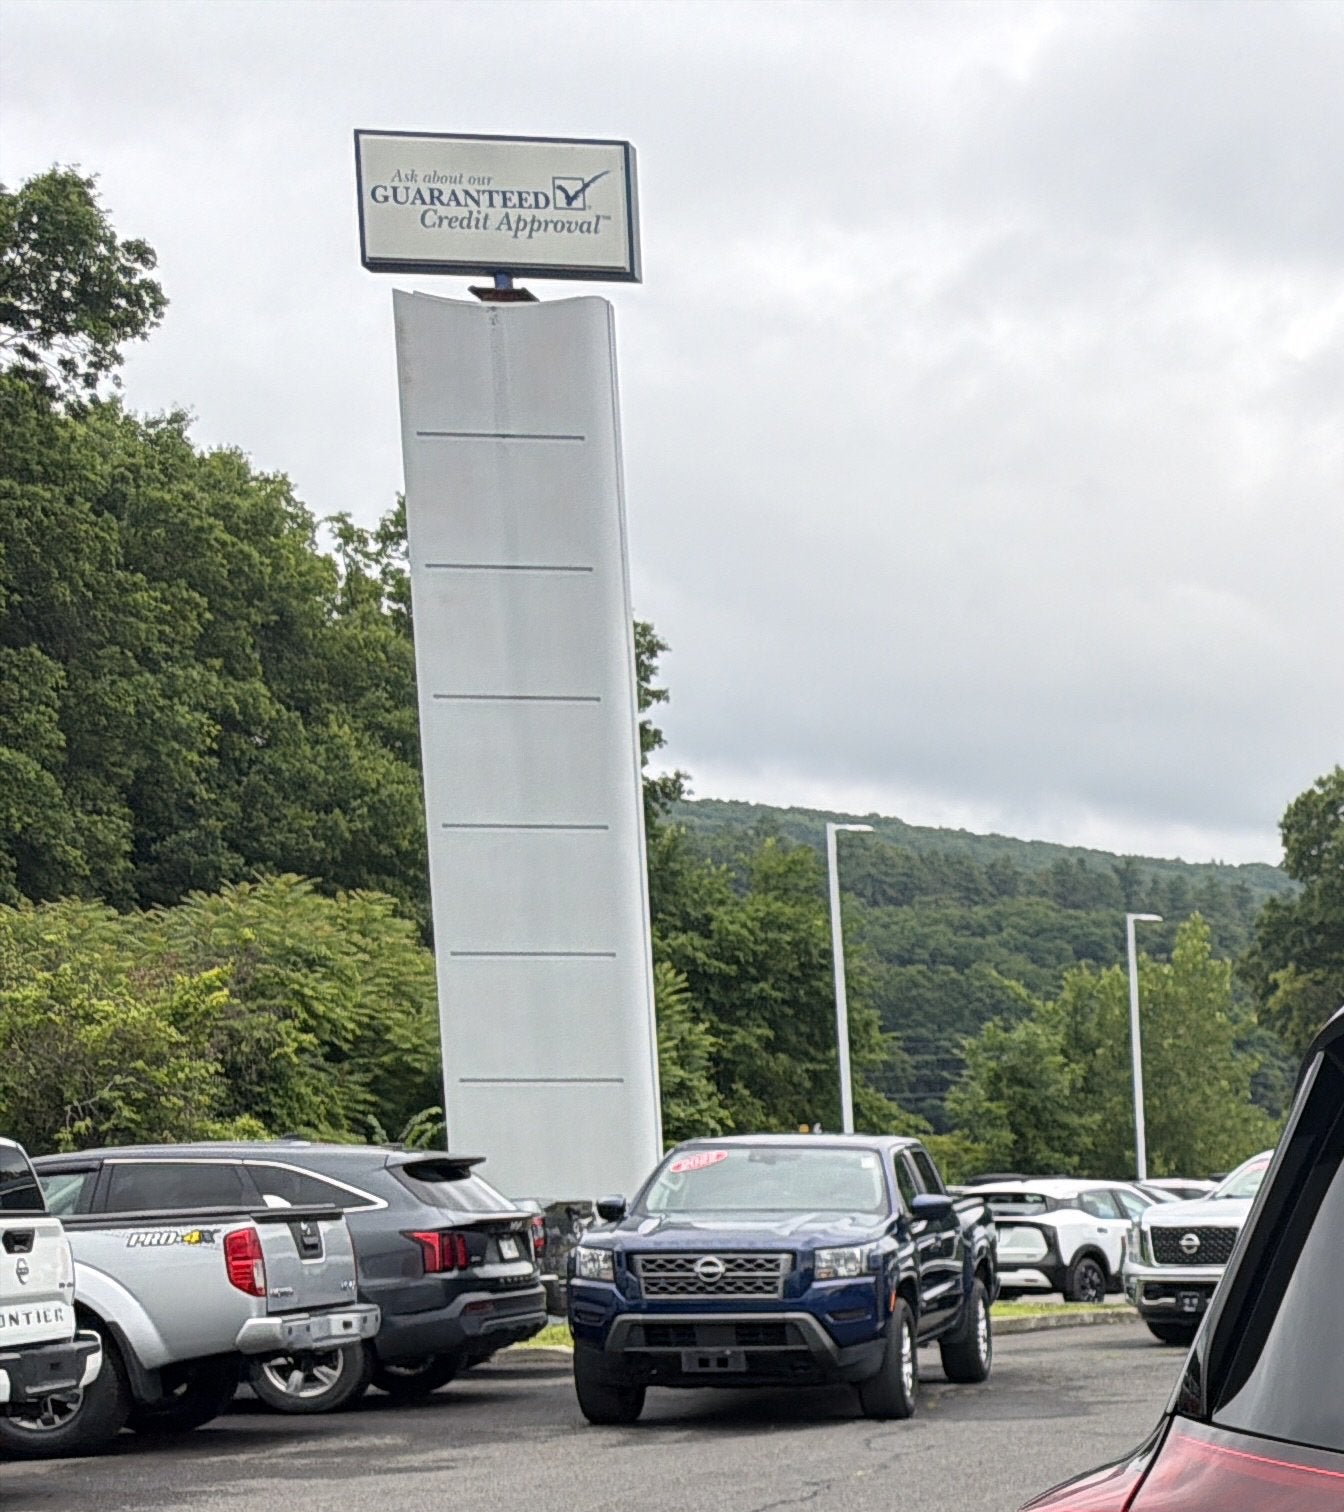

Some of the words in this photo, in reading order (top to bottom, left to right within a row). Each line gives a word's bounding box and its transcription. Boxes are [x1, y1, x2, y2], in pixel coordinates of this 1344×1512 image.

[391, 169, 418, 184] Ask
[423, 170, 464, 186] about
[468, 174, 493, 187] our
[370, 185, 550, 210] GUARANTEED
[420, 208, 489, 231] Credit
